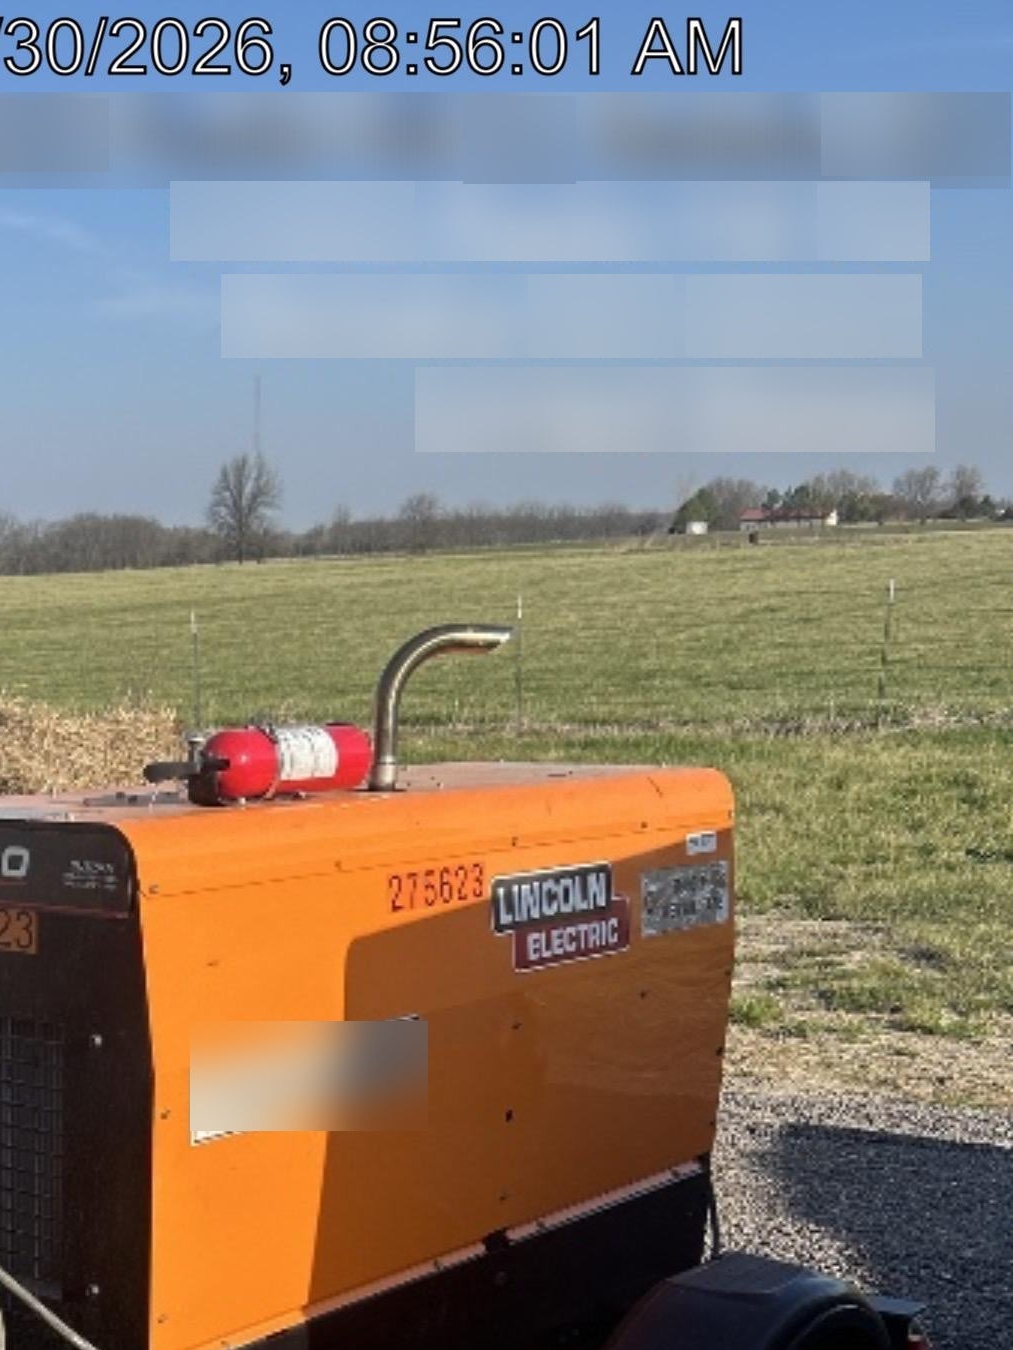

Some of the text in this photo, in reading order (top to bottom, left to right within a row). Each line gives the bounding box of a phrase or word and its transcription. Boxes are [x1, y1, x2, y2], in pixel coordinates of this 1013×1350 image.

[388, 863, 484, 913] 275623
[496, 871, 606, 925] LINCOLN
[526, 917, 619, 961] ELECTRIC
